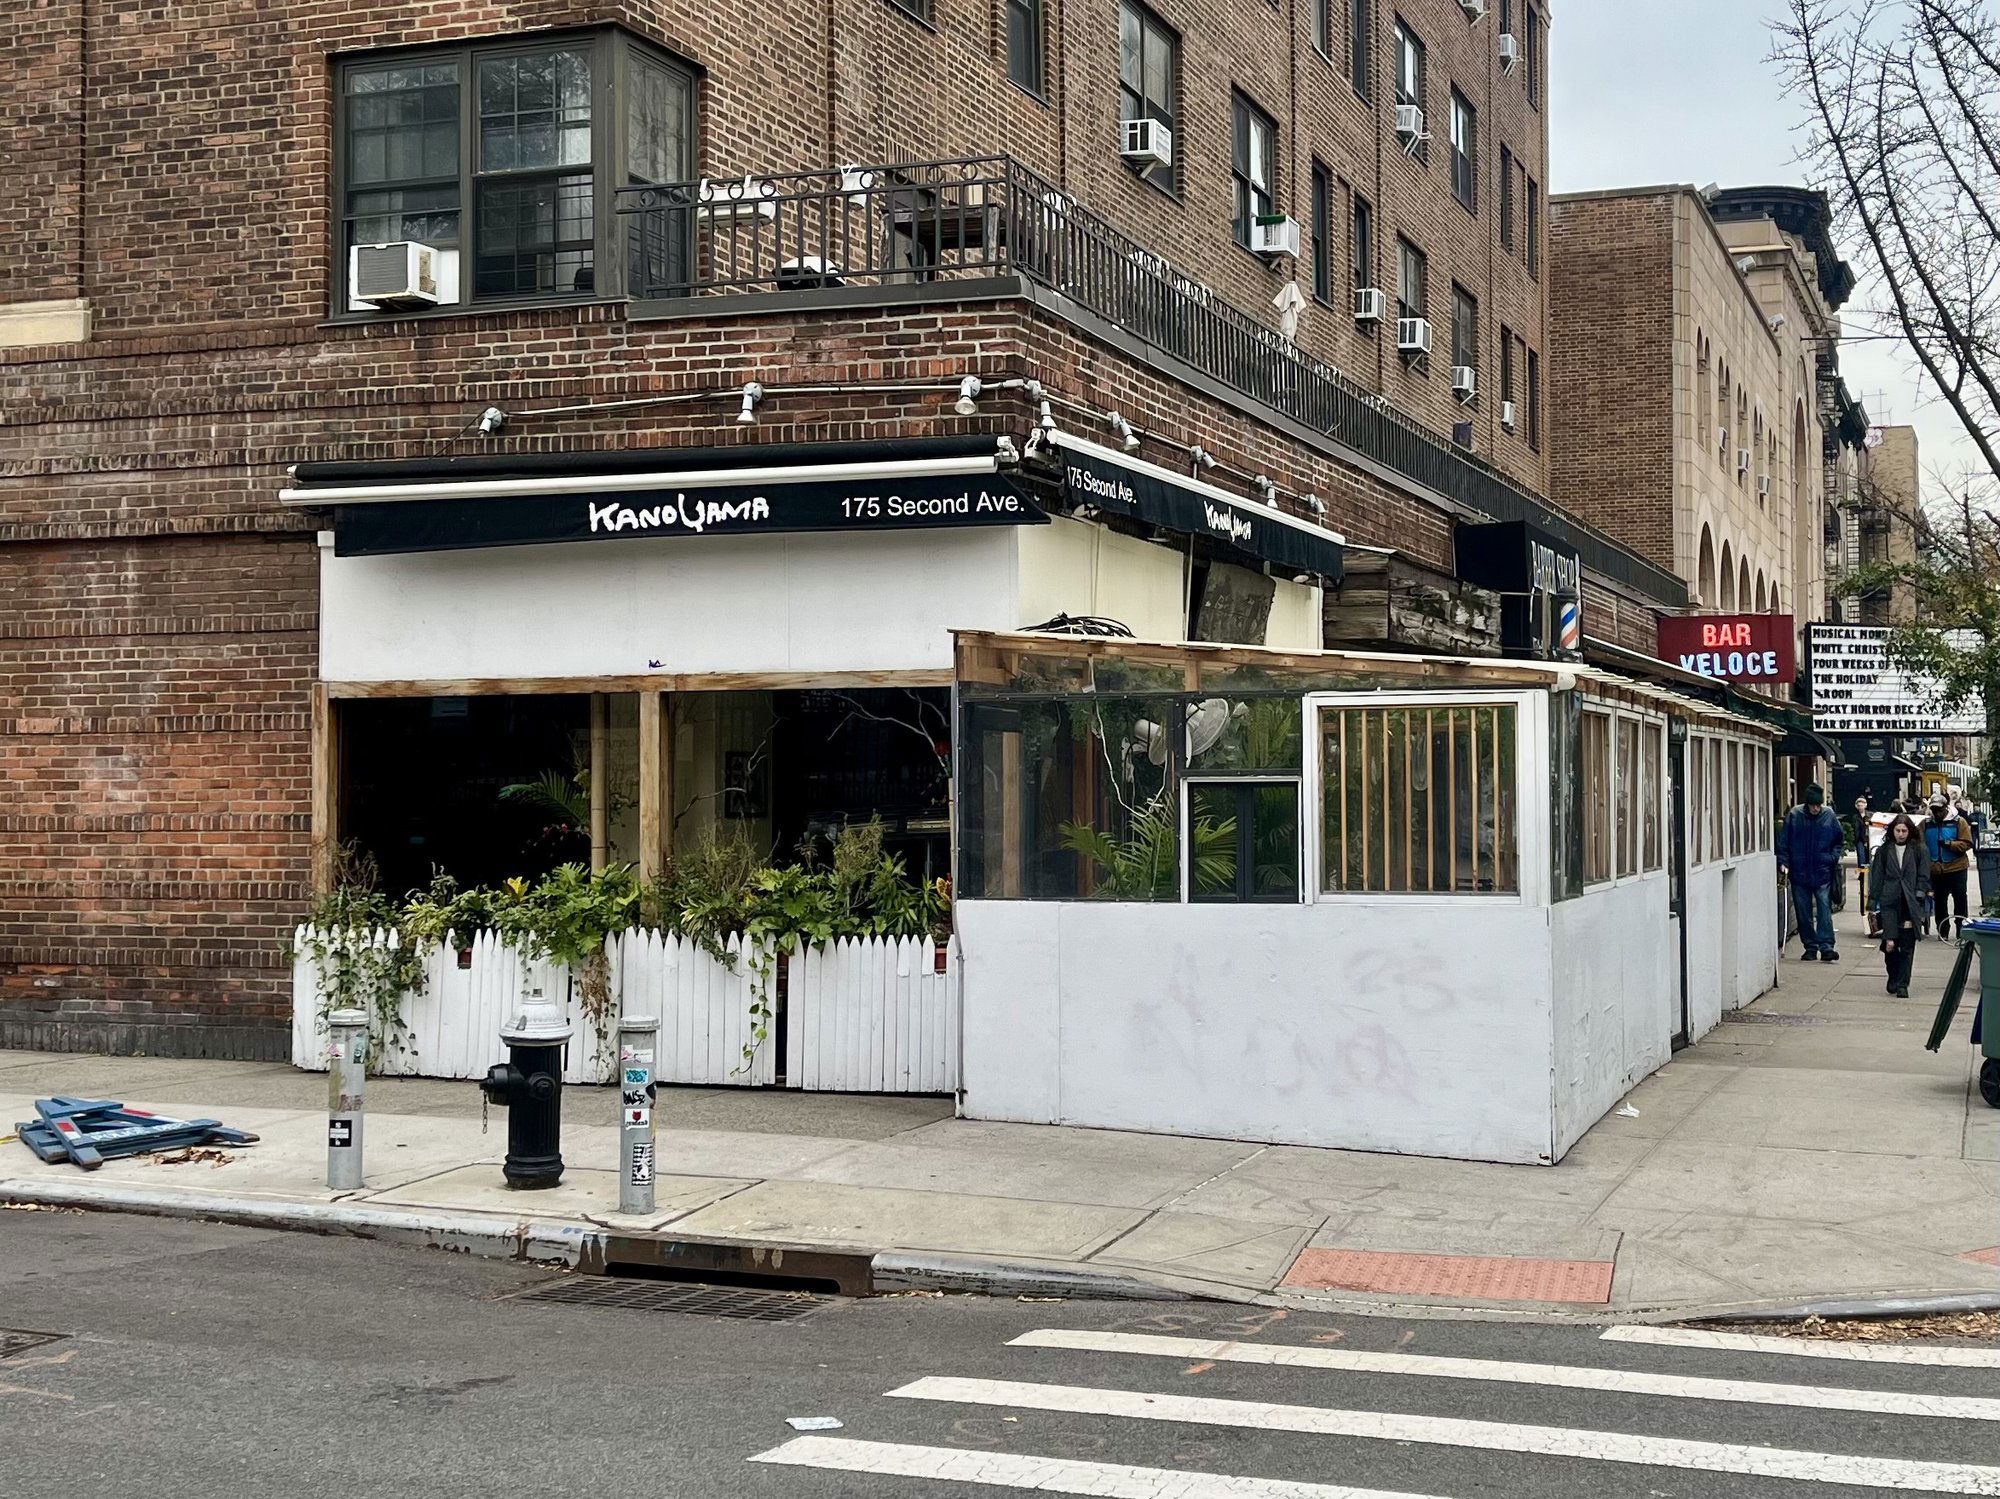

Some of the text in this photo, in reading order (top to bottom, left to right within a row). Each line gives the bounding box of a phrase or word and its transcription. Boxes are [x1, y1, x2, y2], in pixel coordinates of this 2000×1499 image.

[1067, 465, 1082, 489] 175
[1083, 470, 1117, 499] Second
[841, 491, 1025, 517] 175 Second Ave.
[589, 493, 769, 532] KANOYAMA
[1703, 623, 1751, 646] BAR
[1812, 628, 1856, 639] MUSICAL
[1812, 644, 1843, 654] WHITE
[1680, 651, 1778, 676] VELOCE
[1813, 658, 1839, 669] FOUR
[1842, 659, 1875, 669] WEEKS
[1814, 673, 1879, 684] THE HOLIDAY
[1823, 689, 1853, 699] ROOM
[1851, 704, 1892, 715] HORROR
[1894, 704, 1914, 715] DEC
[1814, 719, 1837, 730] WAR
[1839, 719, 1853, 730] OF
[1854, 719, 1875, 730] THE
[1876, 719, 1918, 730] WORLDS
